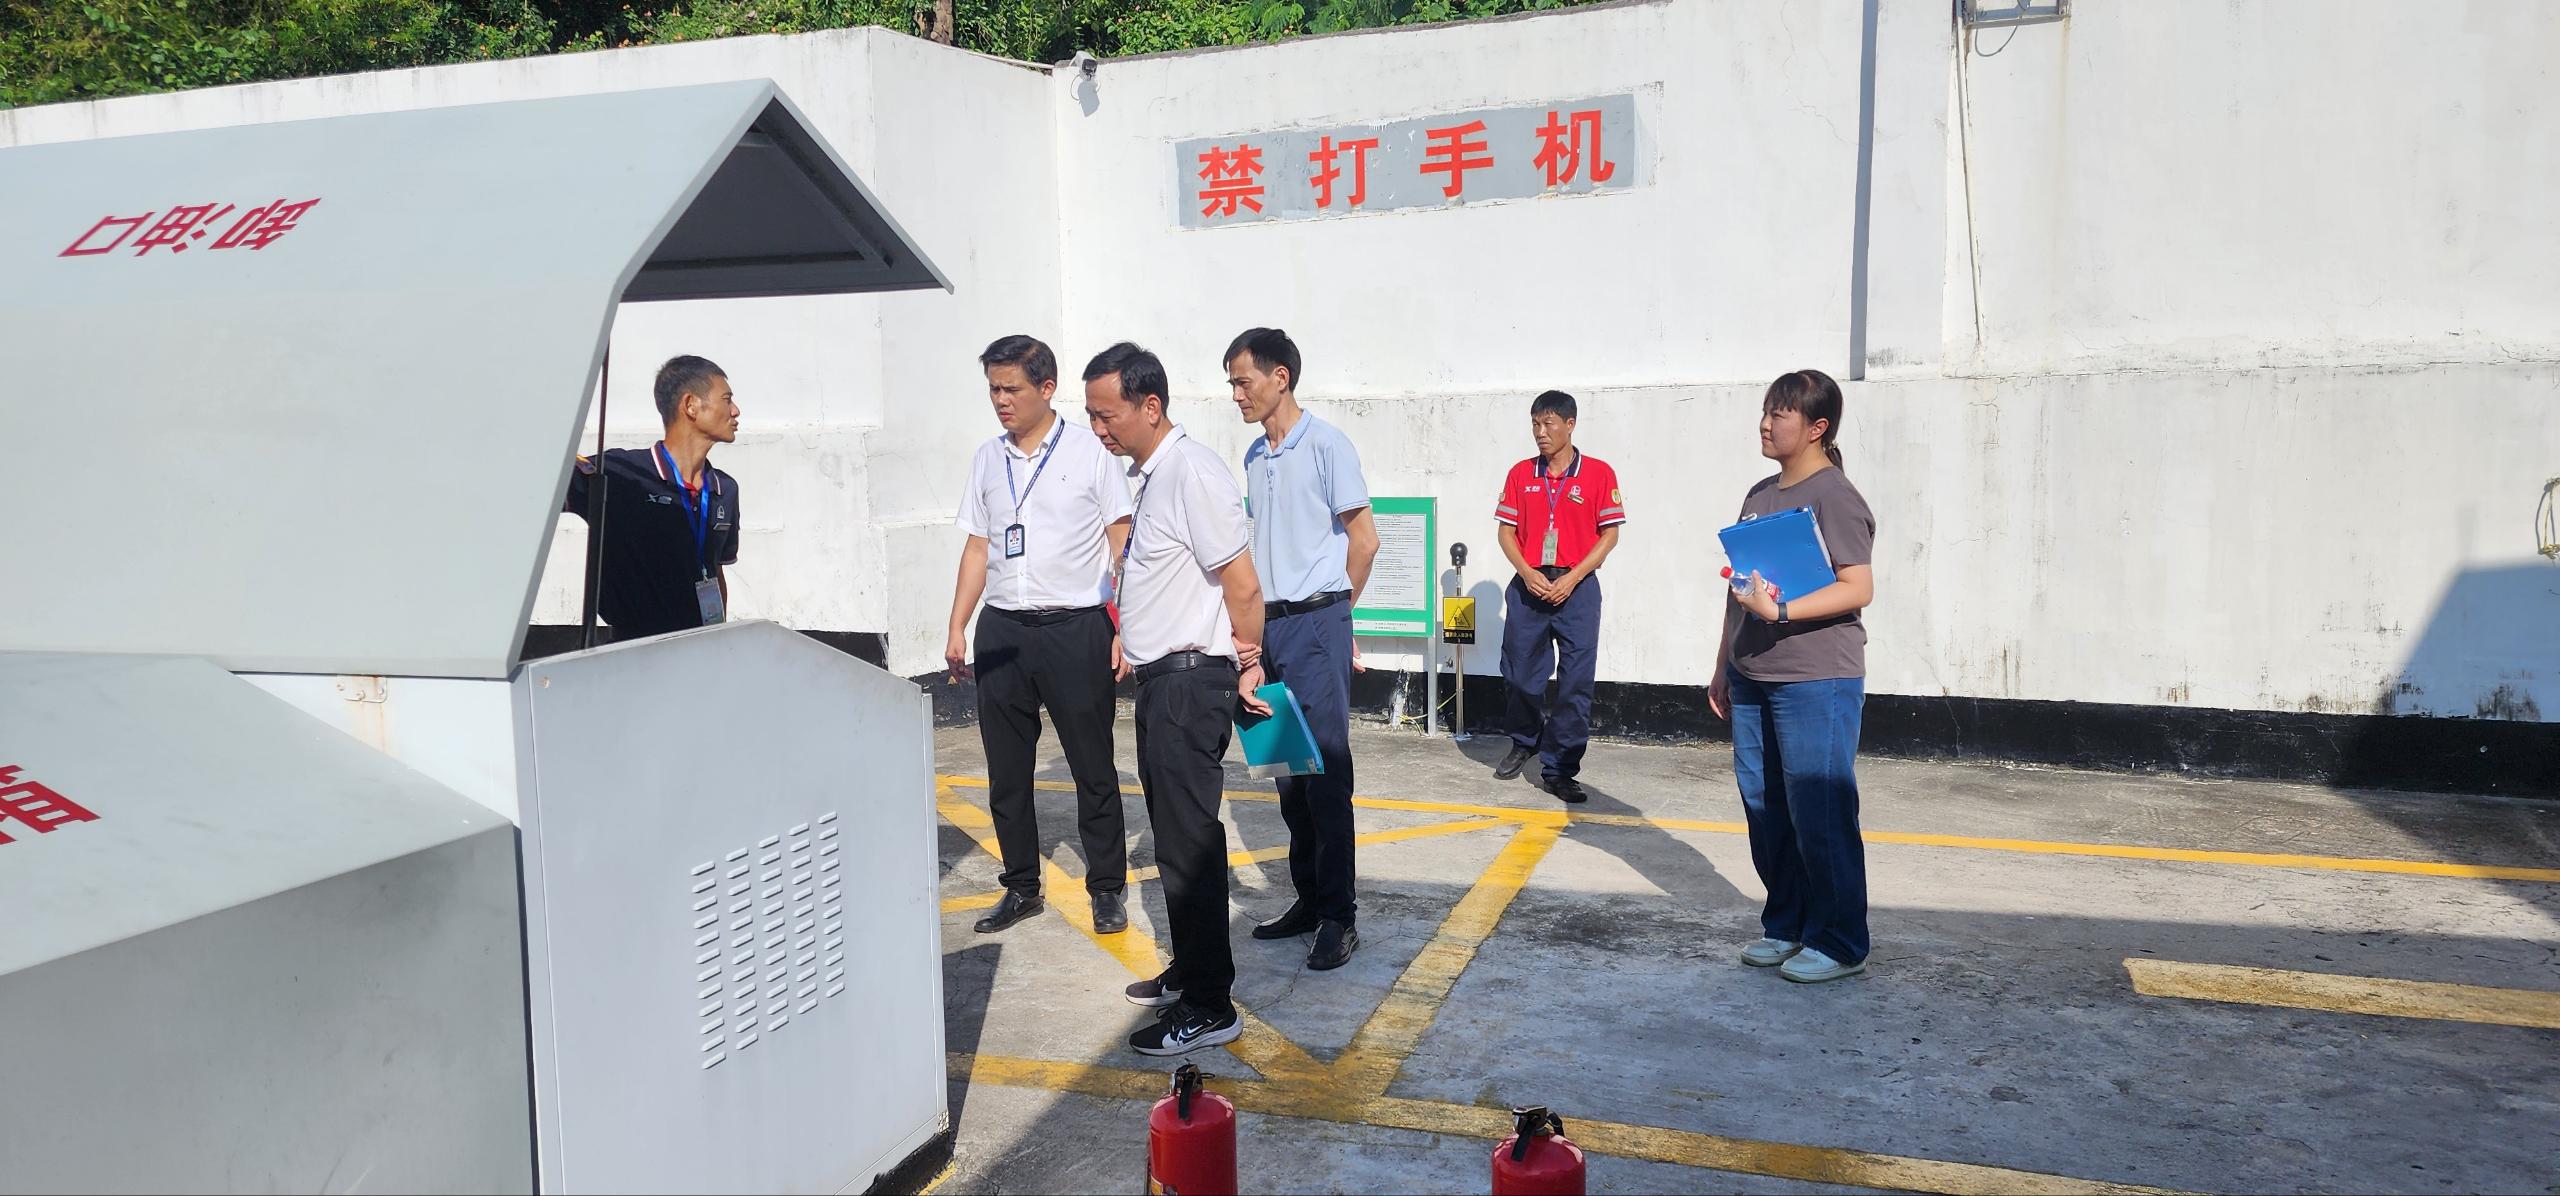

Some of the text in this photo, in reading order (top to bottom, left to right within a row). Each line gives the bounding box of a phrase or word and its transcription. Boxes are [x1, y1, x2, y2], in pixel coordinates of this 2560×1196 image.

[1198, 109, 1616, 218] 禁打手机
[58, 197, 322, 257] 卸油口
